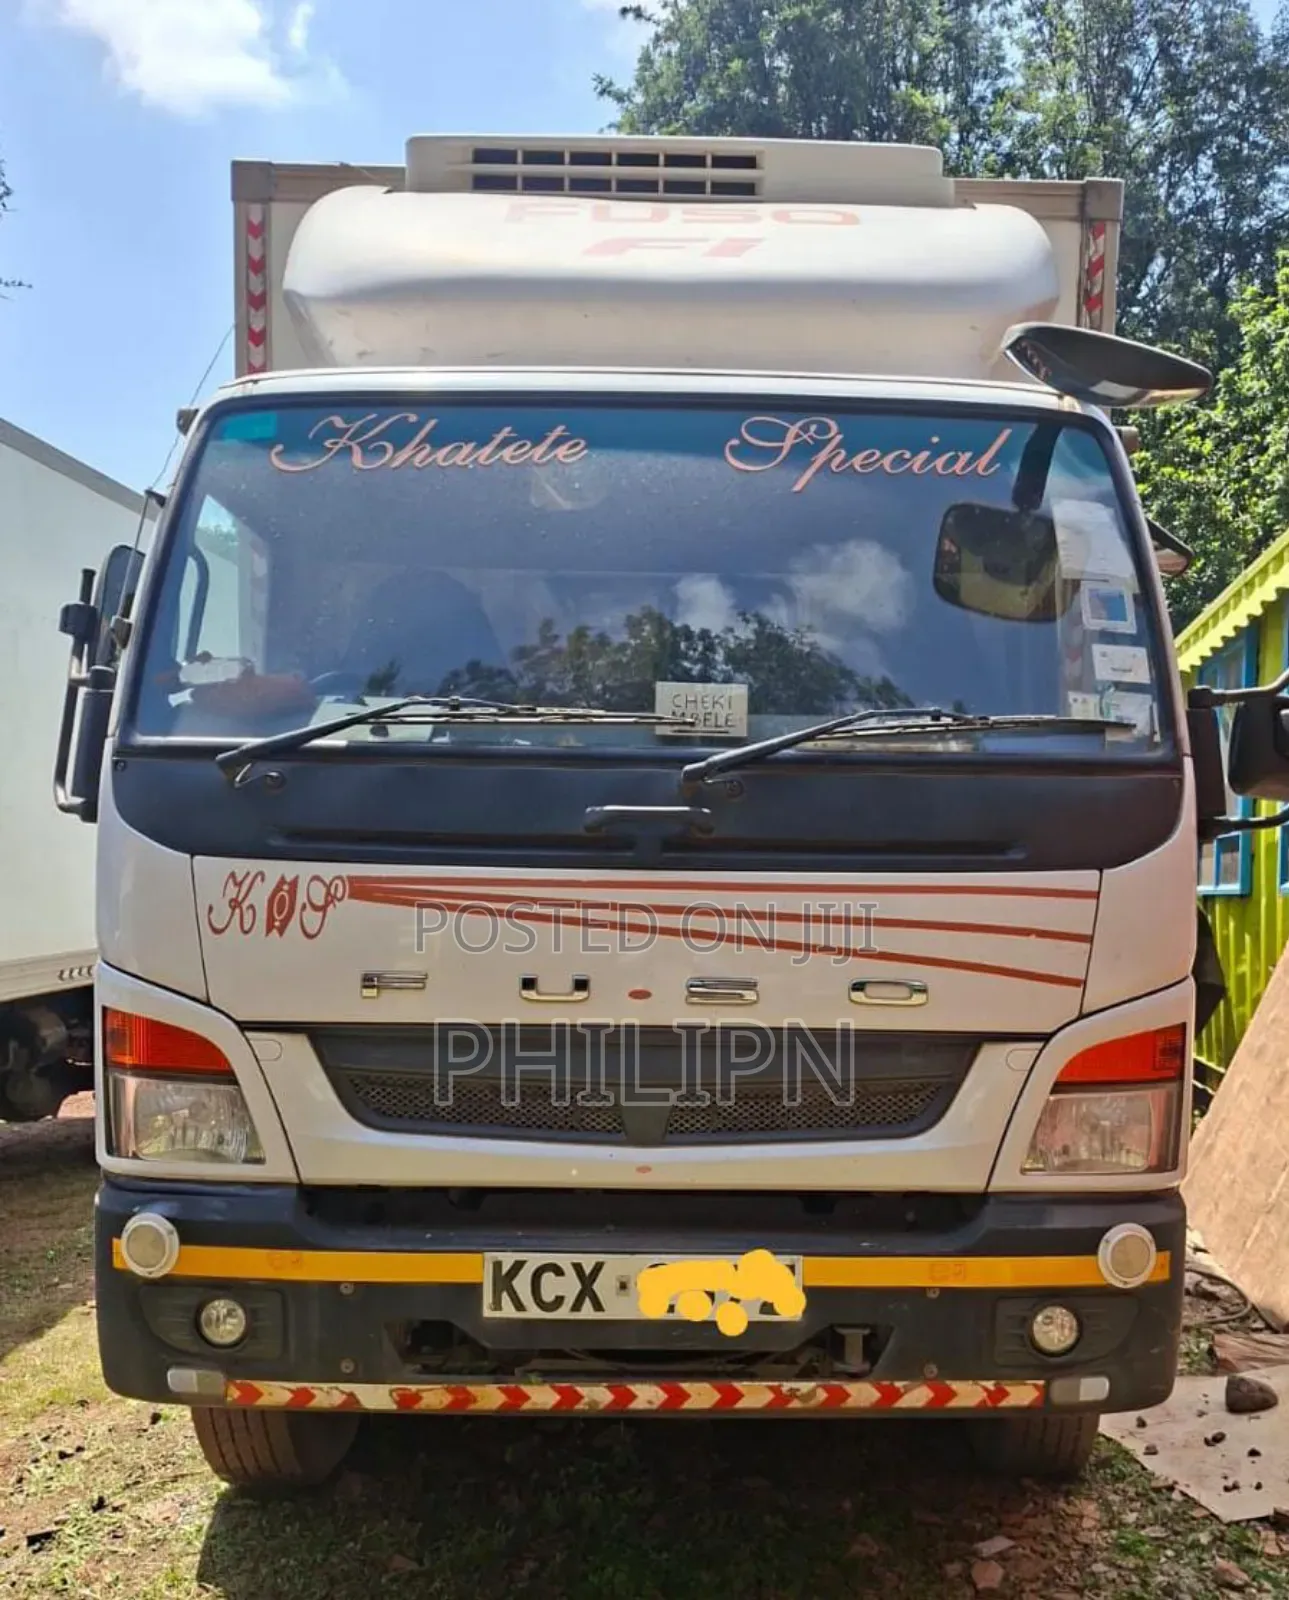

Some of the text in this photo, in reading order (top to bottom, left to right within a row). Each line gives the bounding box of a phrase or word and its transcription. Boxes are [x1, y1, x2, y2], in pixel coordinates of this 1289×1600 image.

[505, 203, 861, 226] FUSO
[270, 412, 1012, 493] Khatete Special
[671, 693, 733, 711] CHEKI
[361, 972, 929, 1006] FUSO
[491, 1259, 606, 1314] KCX
